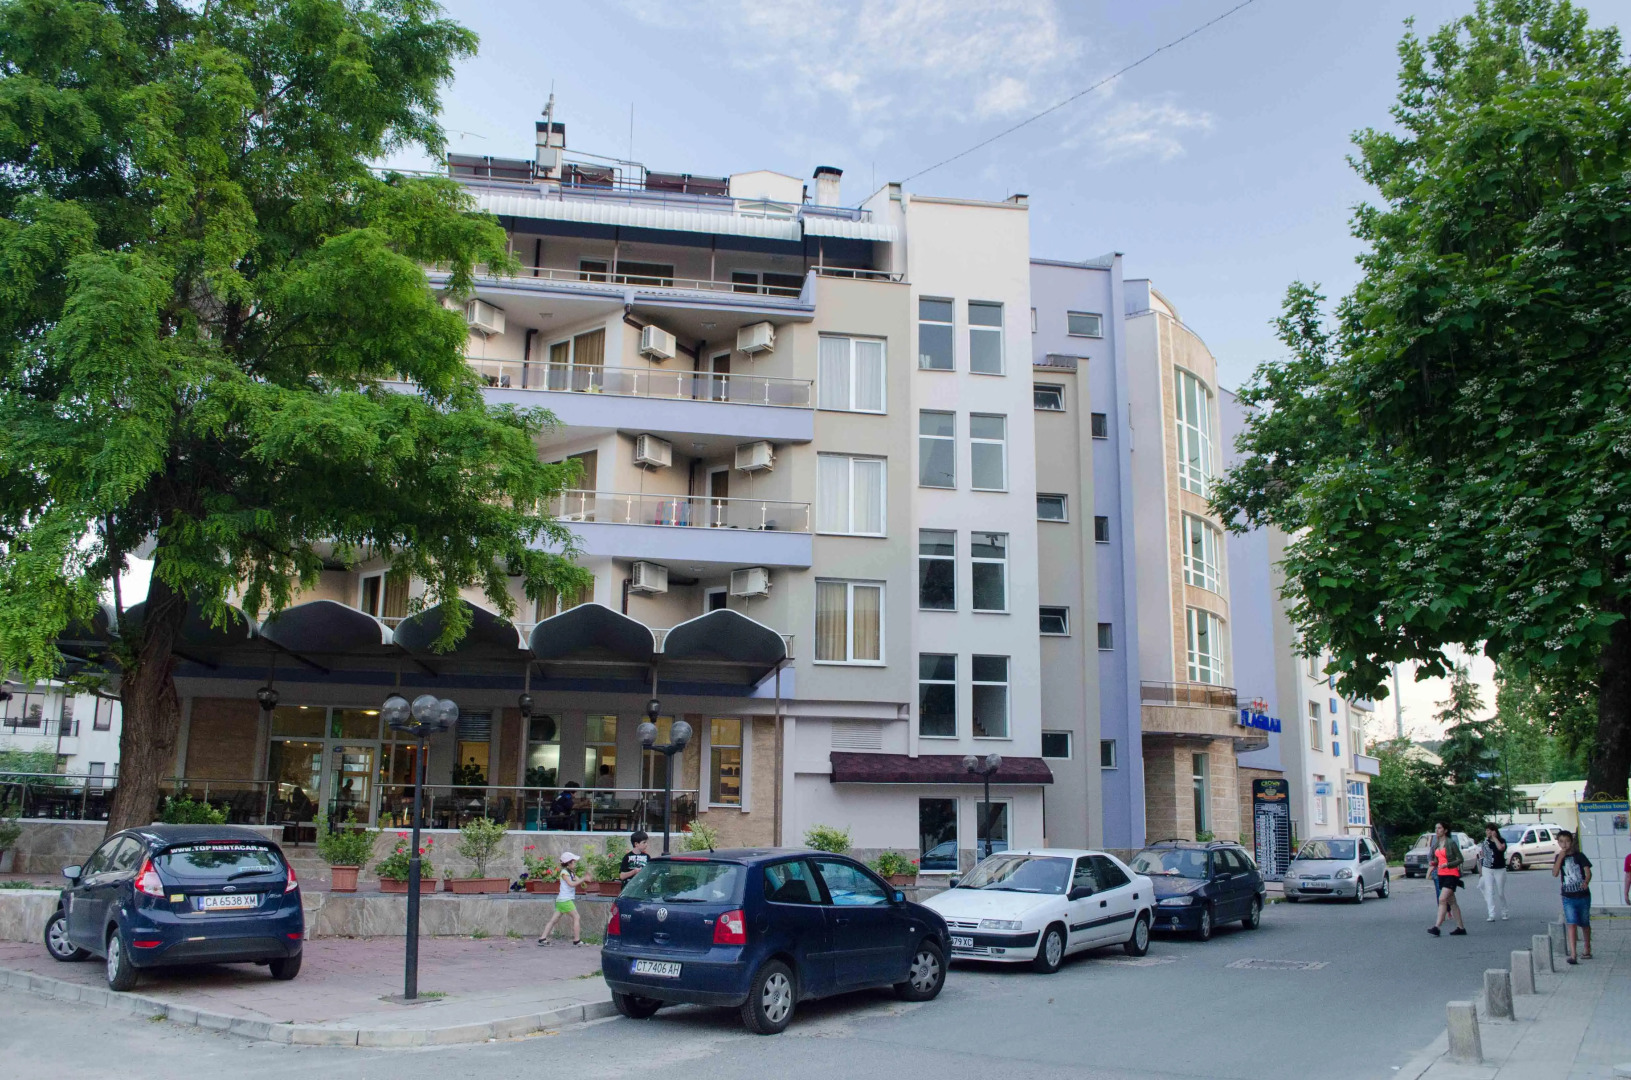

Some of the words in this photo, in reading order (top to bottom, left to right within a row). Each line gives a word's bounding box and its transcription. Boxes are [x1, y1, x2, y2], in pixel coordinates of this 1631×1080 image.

[205, 897, 218, 907] CA
[219, 896, 243, 906] 6538
[244, 894, 256, 905] XM
[963, 938, 973, 946] XC
[668, 965, 680, 975] AH
